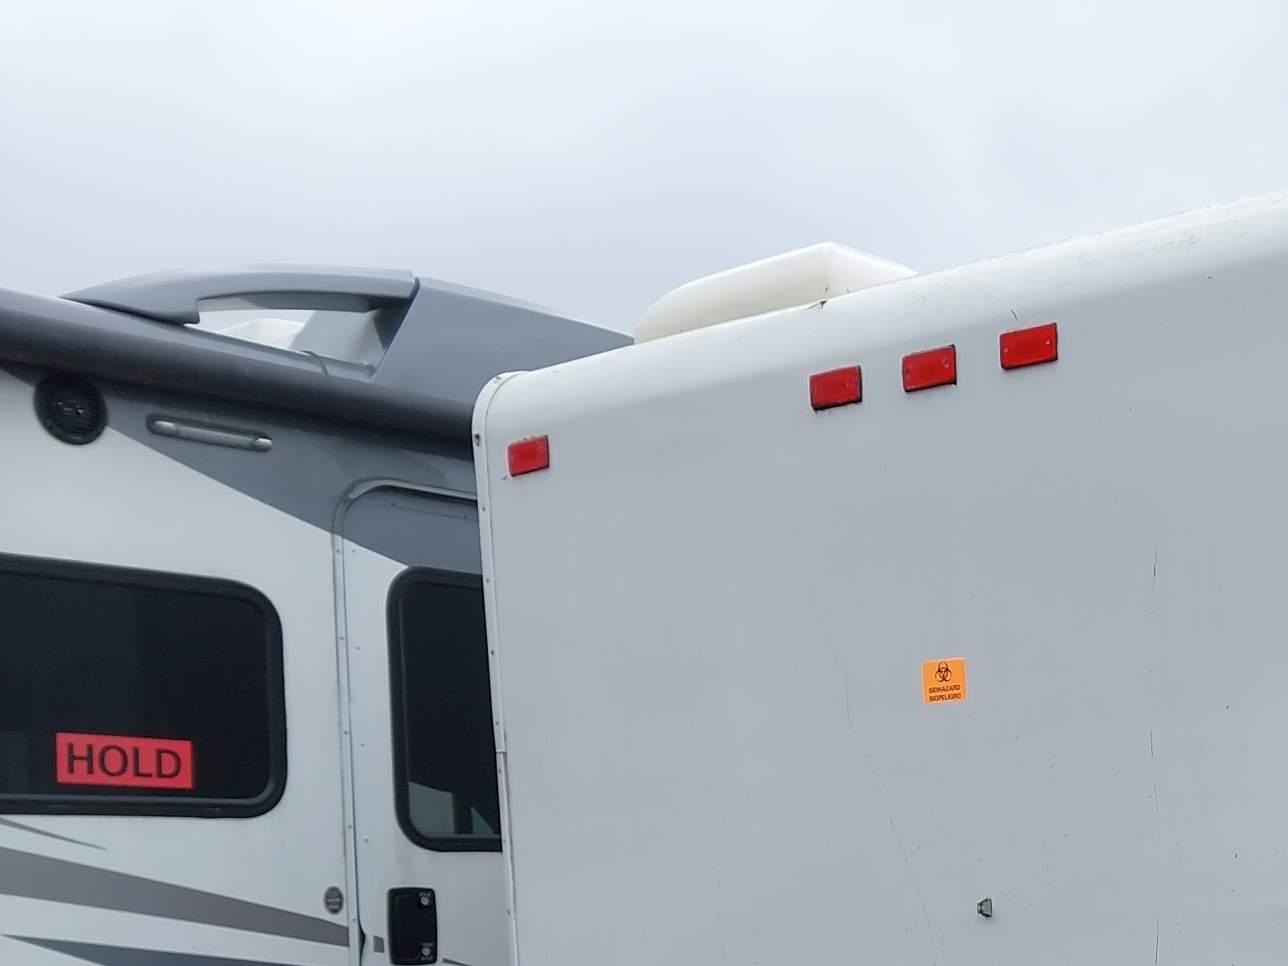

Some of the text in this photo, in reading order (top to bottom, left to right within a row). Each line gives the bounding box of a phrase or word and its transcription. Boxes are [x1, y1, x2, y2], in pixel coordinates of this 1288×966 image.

[928, 684, 961, 693] BIOHAZARD
[928, 693, 962, 702] BIOPELIGRO
[67, 742, 182, 779] HOLD
